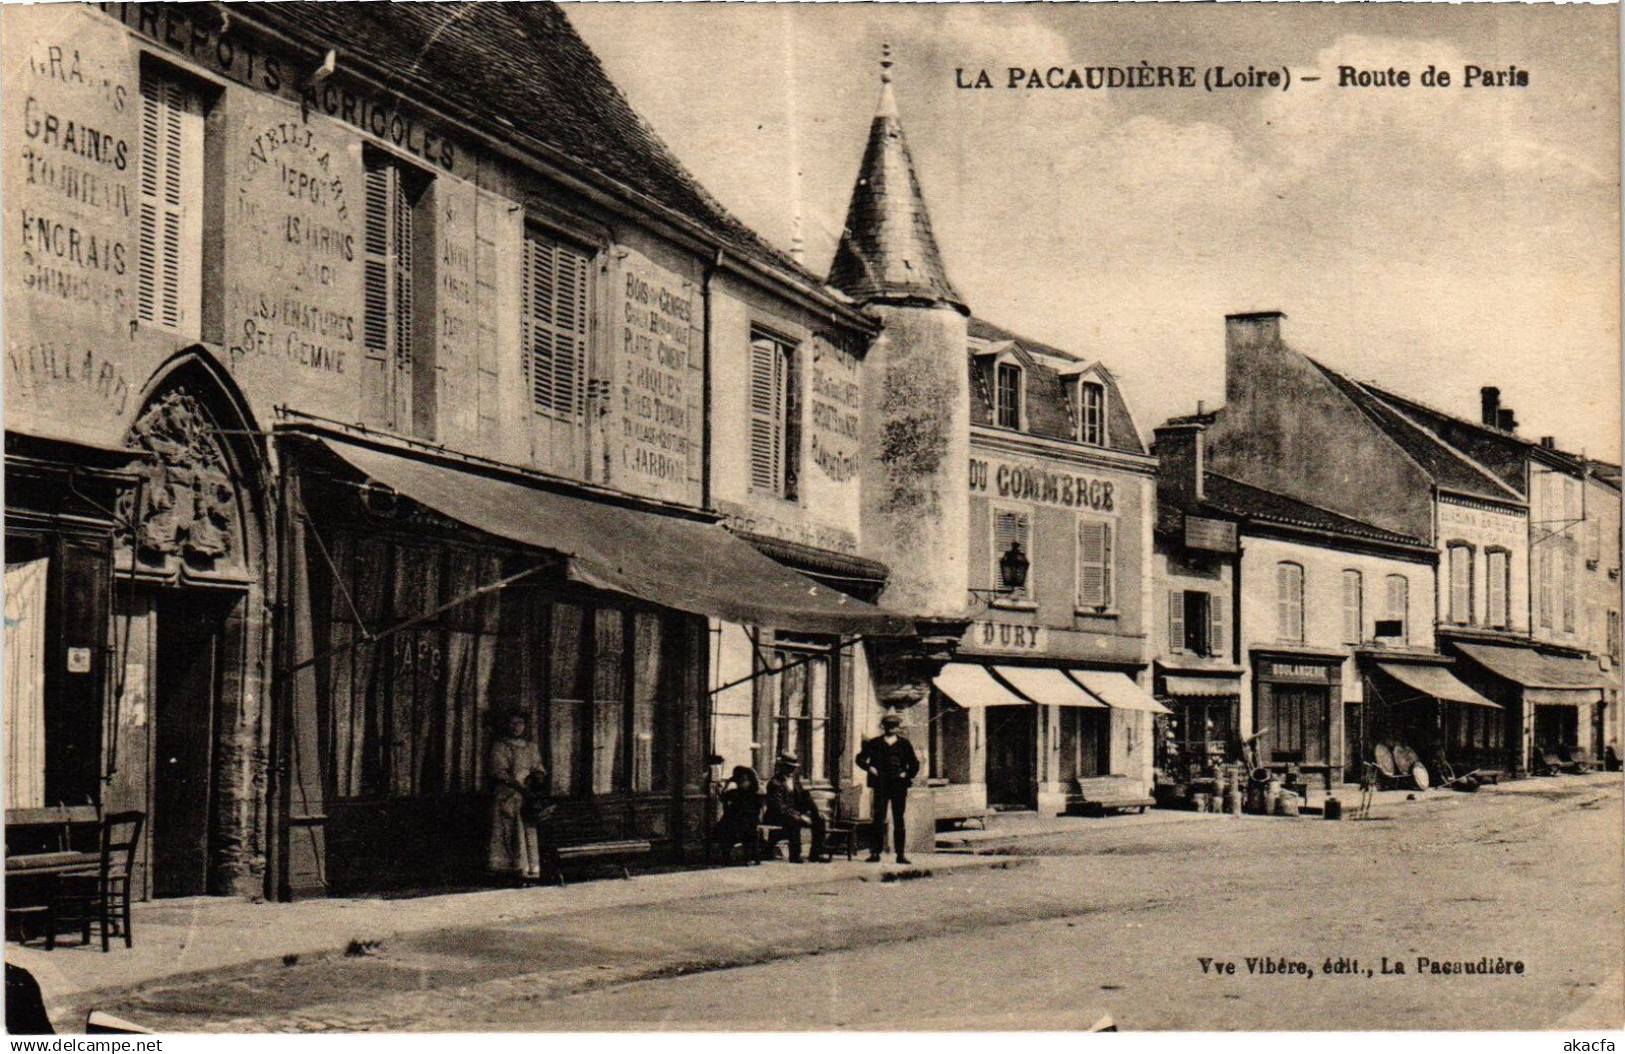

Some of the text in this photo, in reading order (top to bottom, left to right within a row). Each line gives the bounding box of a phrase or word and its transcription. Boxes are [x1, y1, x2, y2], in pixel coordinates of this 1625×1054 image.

[968, 458, 1115, 511] DU COMMERCE
[984, 623, 1040, 647] DURY
